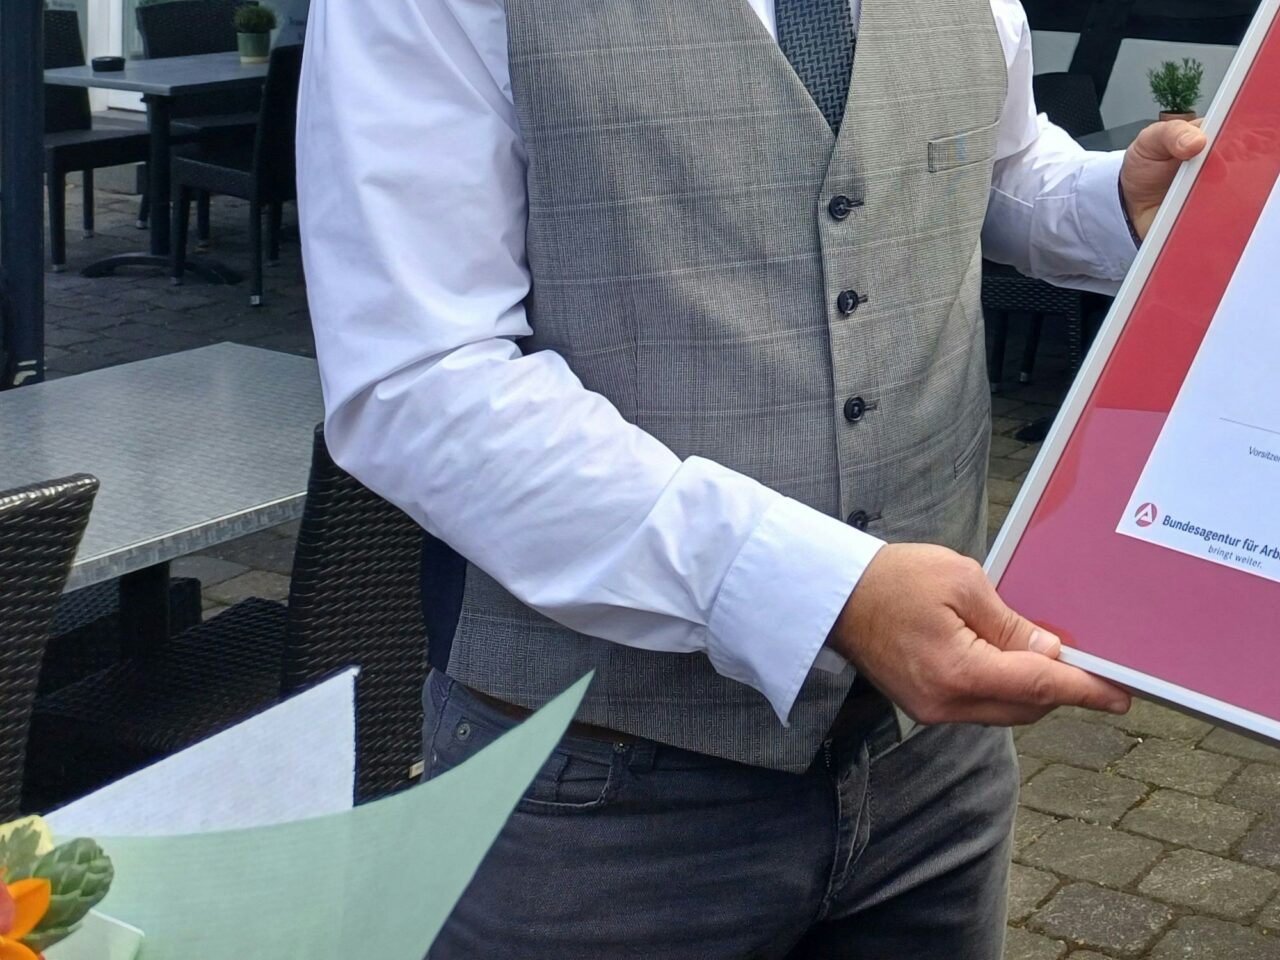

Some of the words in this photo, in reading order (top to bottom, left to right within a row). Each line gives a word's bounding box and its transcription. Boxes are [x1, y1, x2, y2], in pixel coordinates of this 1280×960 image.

[1162, 514, 1242, 547] Bundesagentur
[1242, 538, 1259, 553] für
[1208, 544, 1233, 561] bringt
[1235, 552, 1263, 569] weiter.
